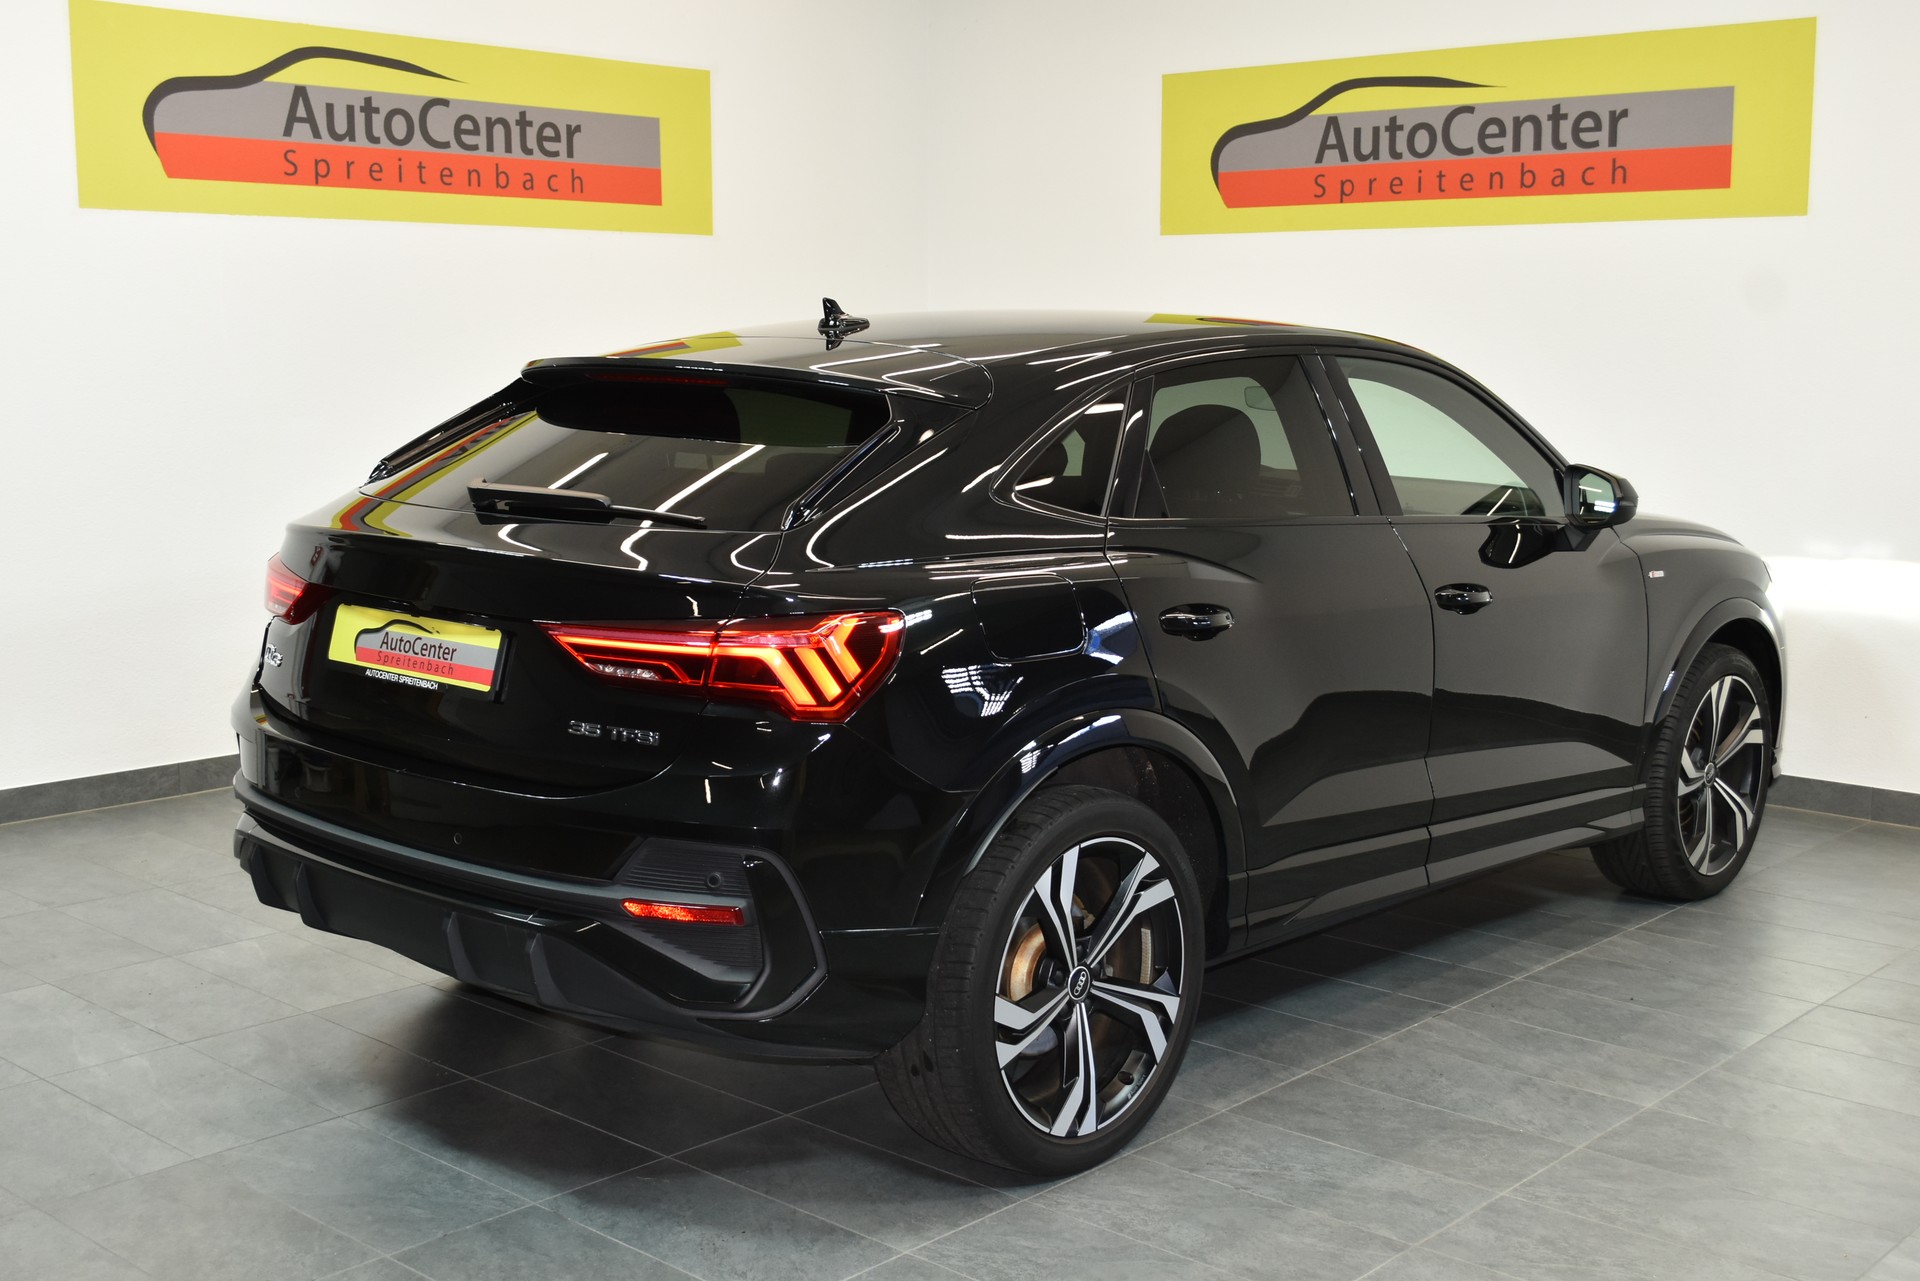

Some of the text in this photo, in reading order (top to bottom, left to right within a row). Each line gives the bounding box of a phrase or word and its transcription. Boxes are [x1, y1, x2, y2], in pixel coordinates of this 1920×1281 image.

[282, 85, 582, 159] AutoCenter
[1313, 102, 1629, 164] AutoCenter
[283, 149, 584, 194] Spreitenbach
[1313, 157, 1628, 204] Spreitenbach
[376, 650, 454, 675] Spreitenbach
[379, 631, 457, 662] AutoCenter
[365, 668, 439, 691] AUTOCENTER SPREITENBACH
[567, 720, 601, 738] 35
